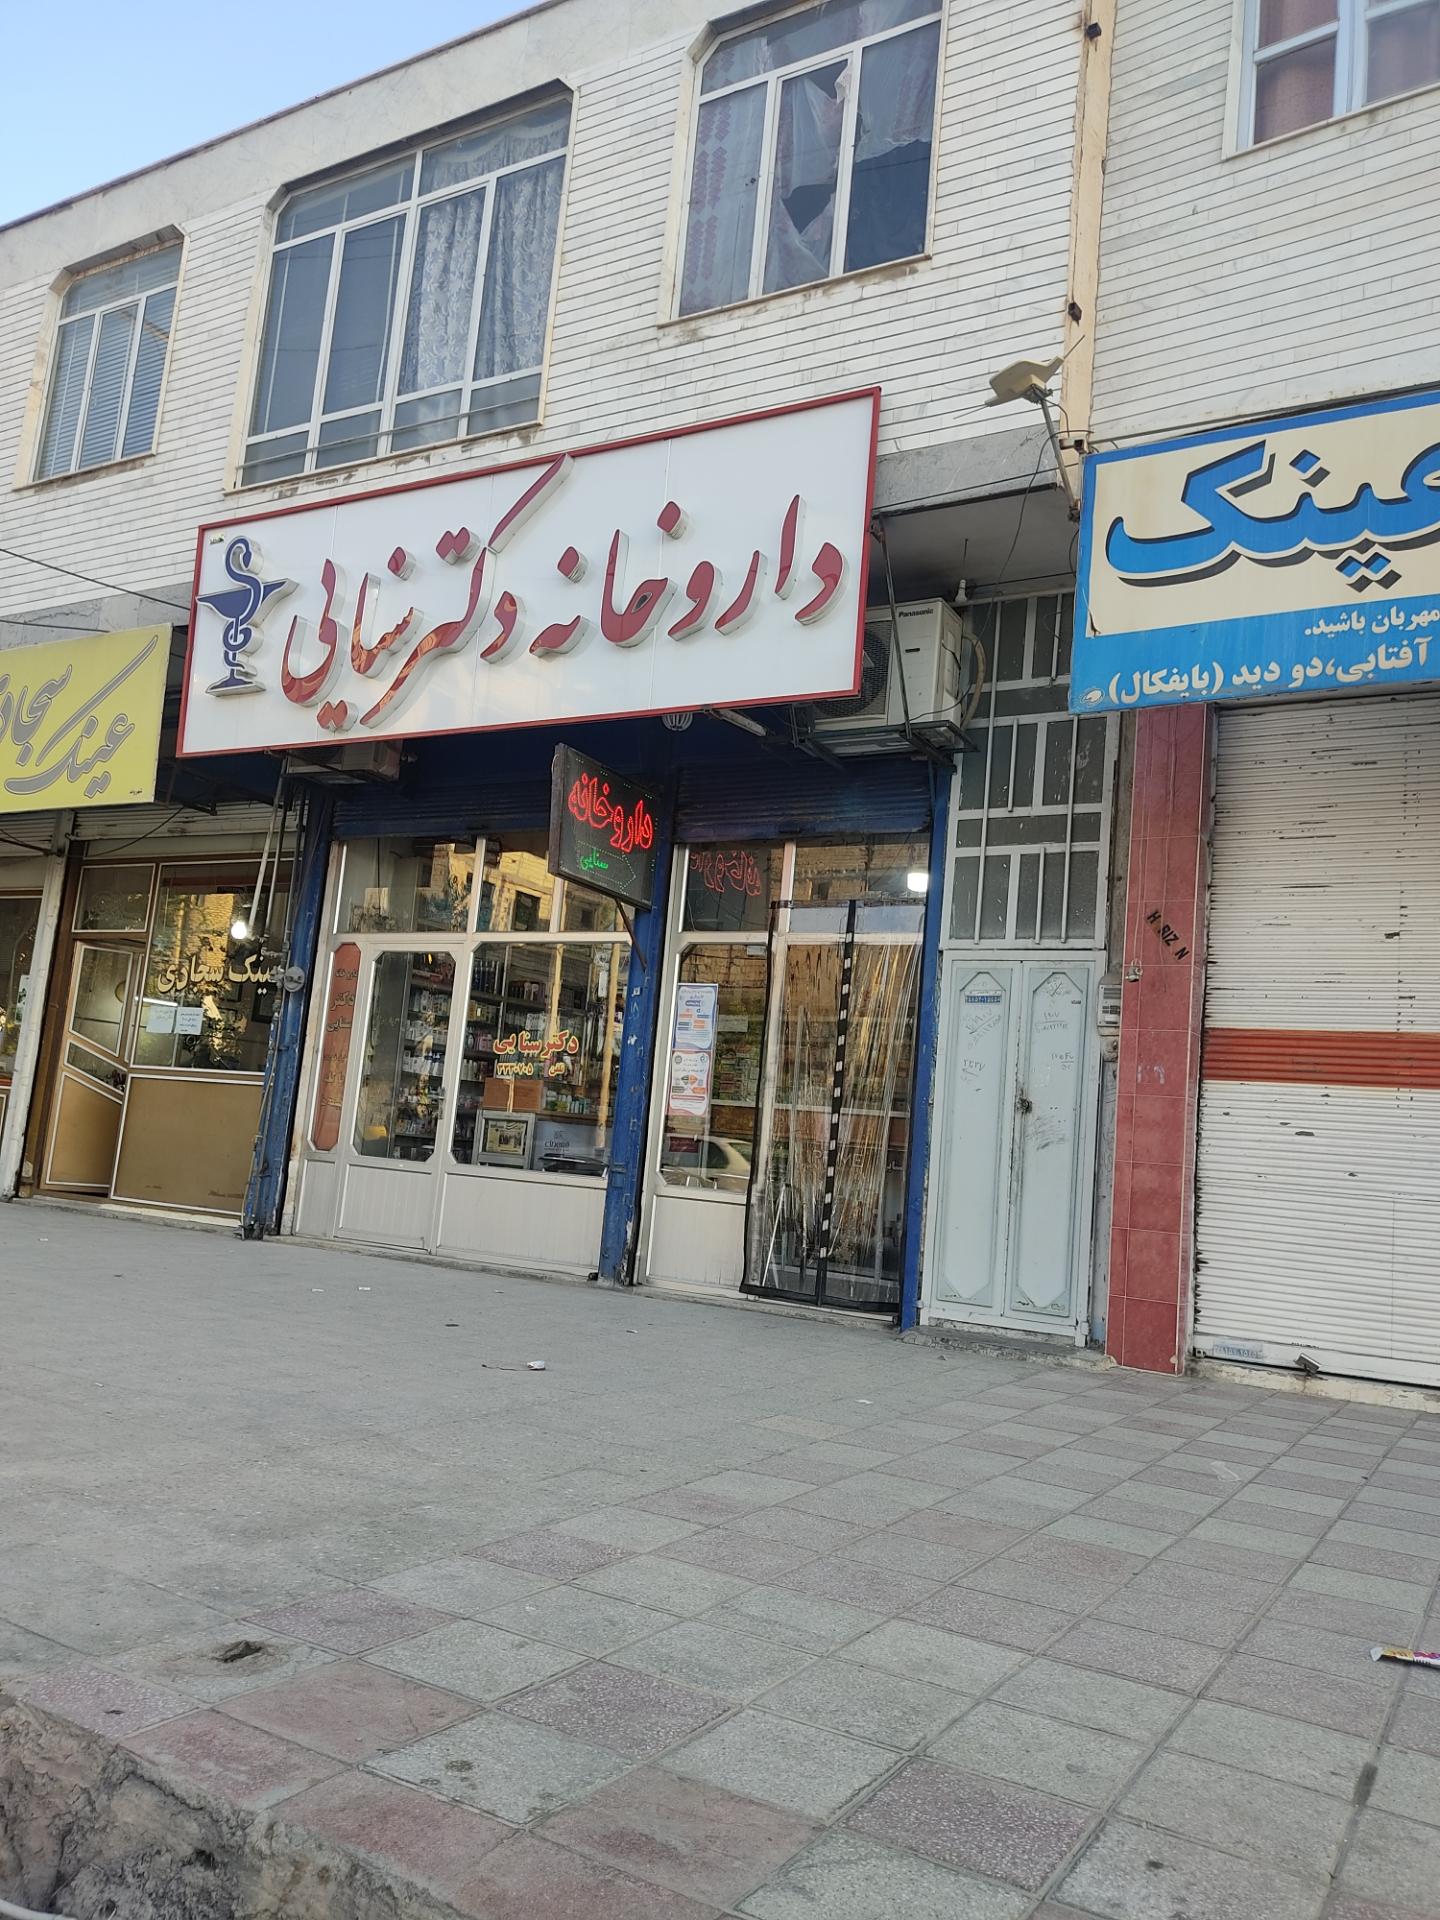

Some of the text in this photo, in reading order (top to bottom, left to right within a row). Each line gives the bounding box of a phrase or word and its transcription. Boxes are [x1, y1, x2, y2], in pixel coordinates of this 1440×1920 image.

[281, 453, 849, 732] داروخانه دکتر سنایی
[898, 608, 934, 618] Panasonic
[1305, 610, 1366, 638] باشید.
[1108, 660, 1224, 705] (بایفکال)
[1232, 661, 1281, 690] دید
[3, 634, 159, 799] عینک
[568, 772, 653, 853] داروخانه
[157, 955, 224, 994] سجادی
[493, 1029, 579, 1059] دکتر سنایی
